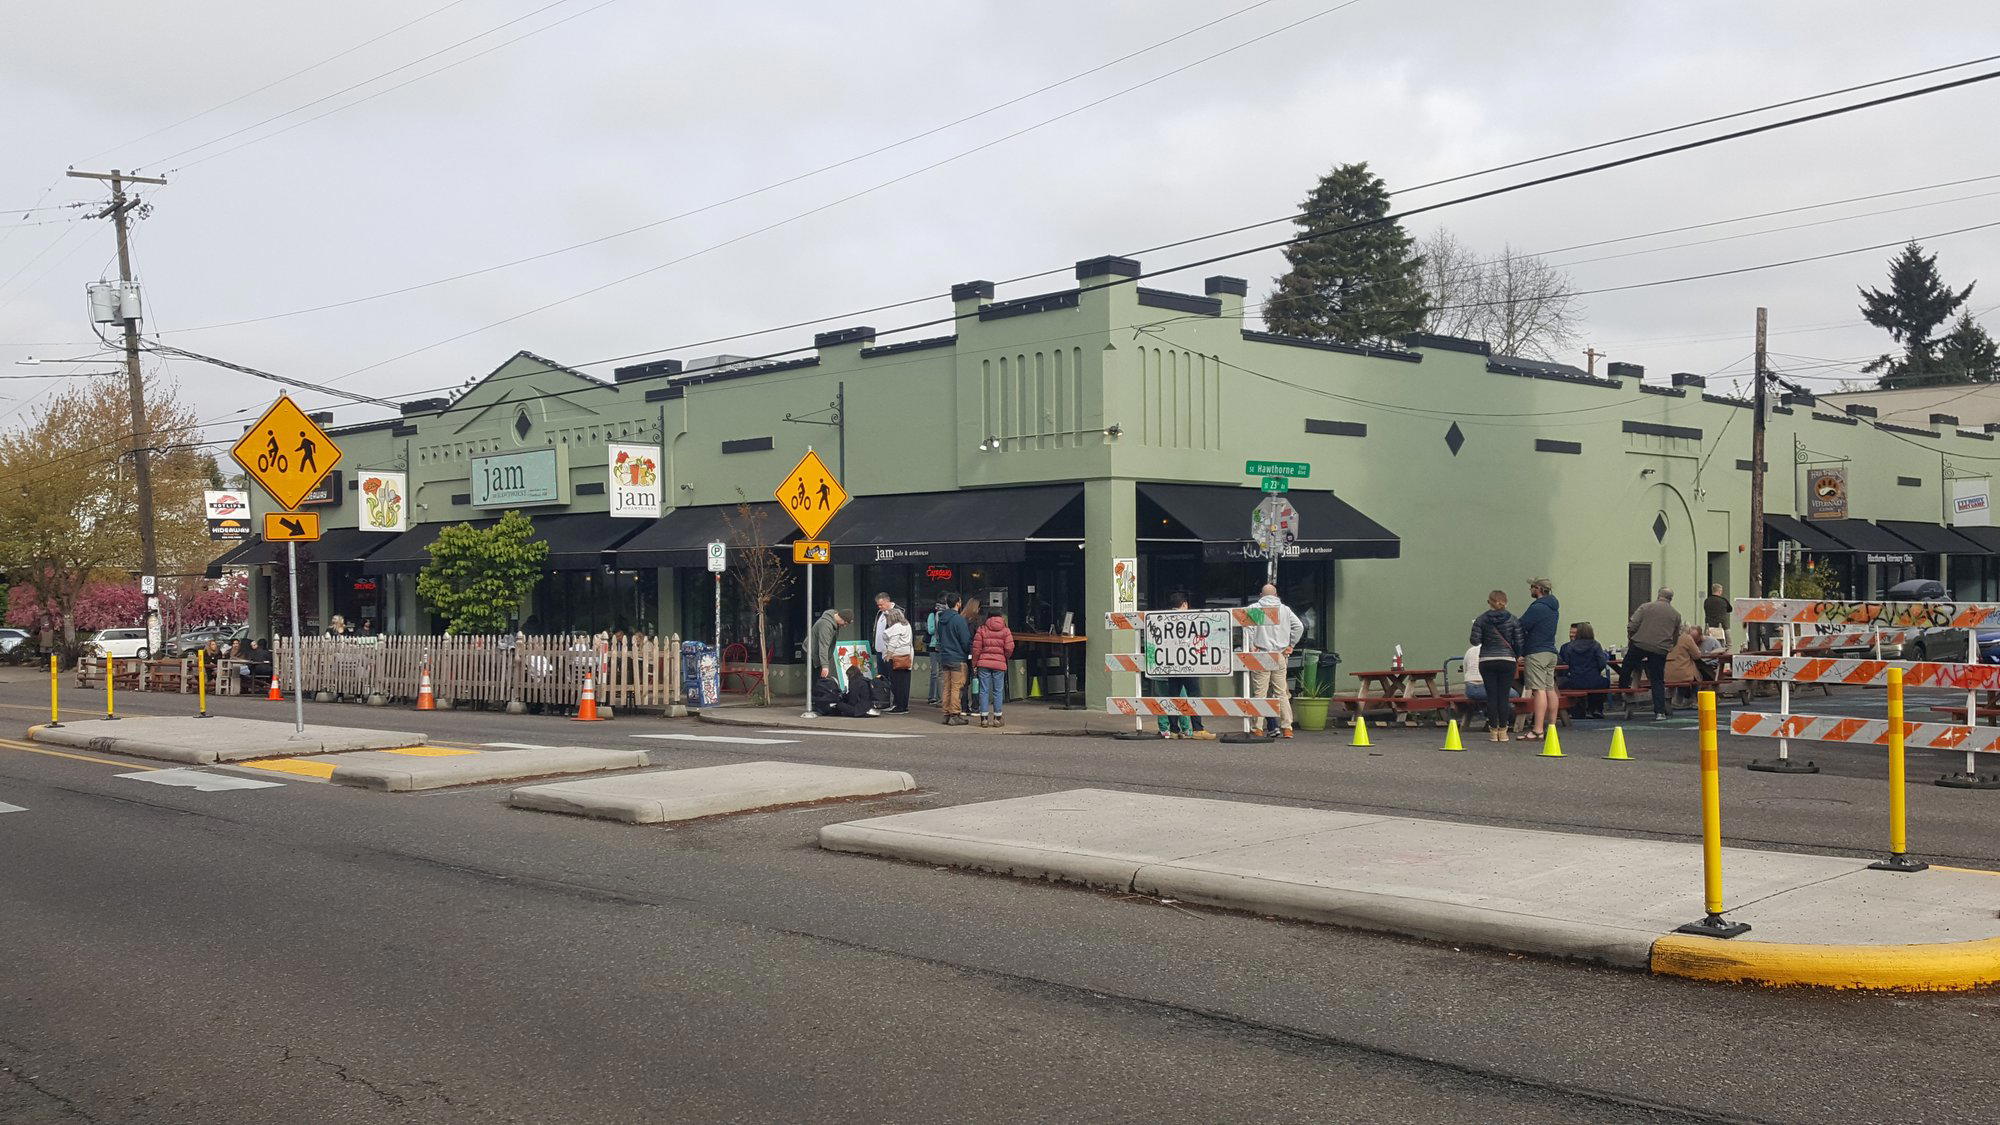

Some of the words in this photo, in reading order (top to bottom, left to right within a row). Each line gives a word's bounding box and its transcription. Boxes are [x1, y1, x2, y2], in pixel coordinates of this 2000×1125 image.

[1257, 465, 1294, 475] Hawthorne
[482, 459, 525, 501] jam
[615, 486, 656, 511] jam
[875, 546, 894, 561] jam
[1867, 553, 1886, 562] Hawthorne
[1886, 553, 1903, 564] Veterinary
[1903, 553, 1914, 562] Clinic
[1164, 621, 1210, 640] ROAD
[1154, 646, 1222, 667] CLOSED
